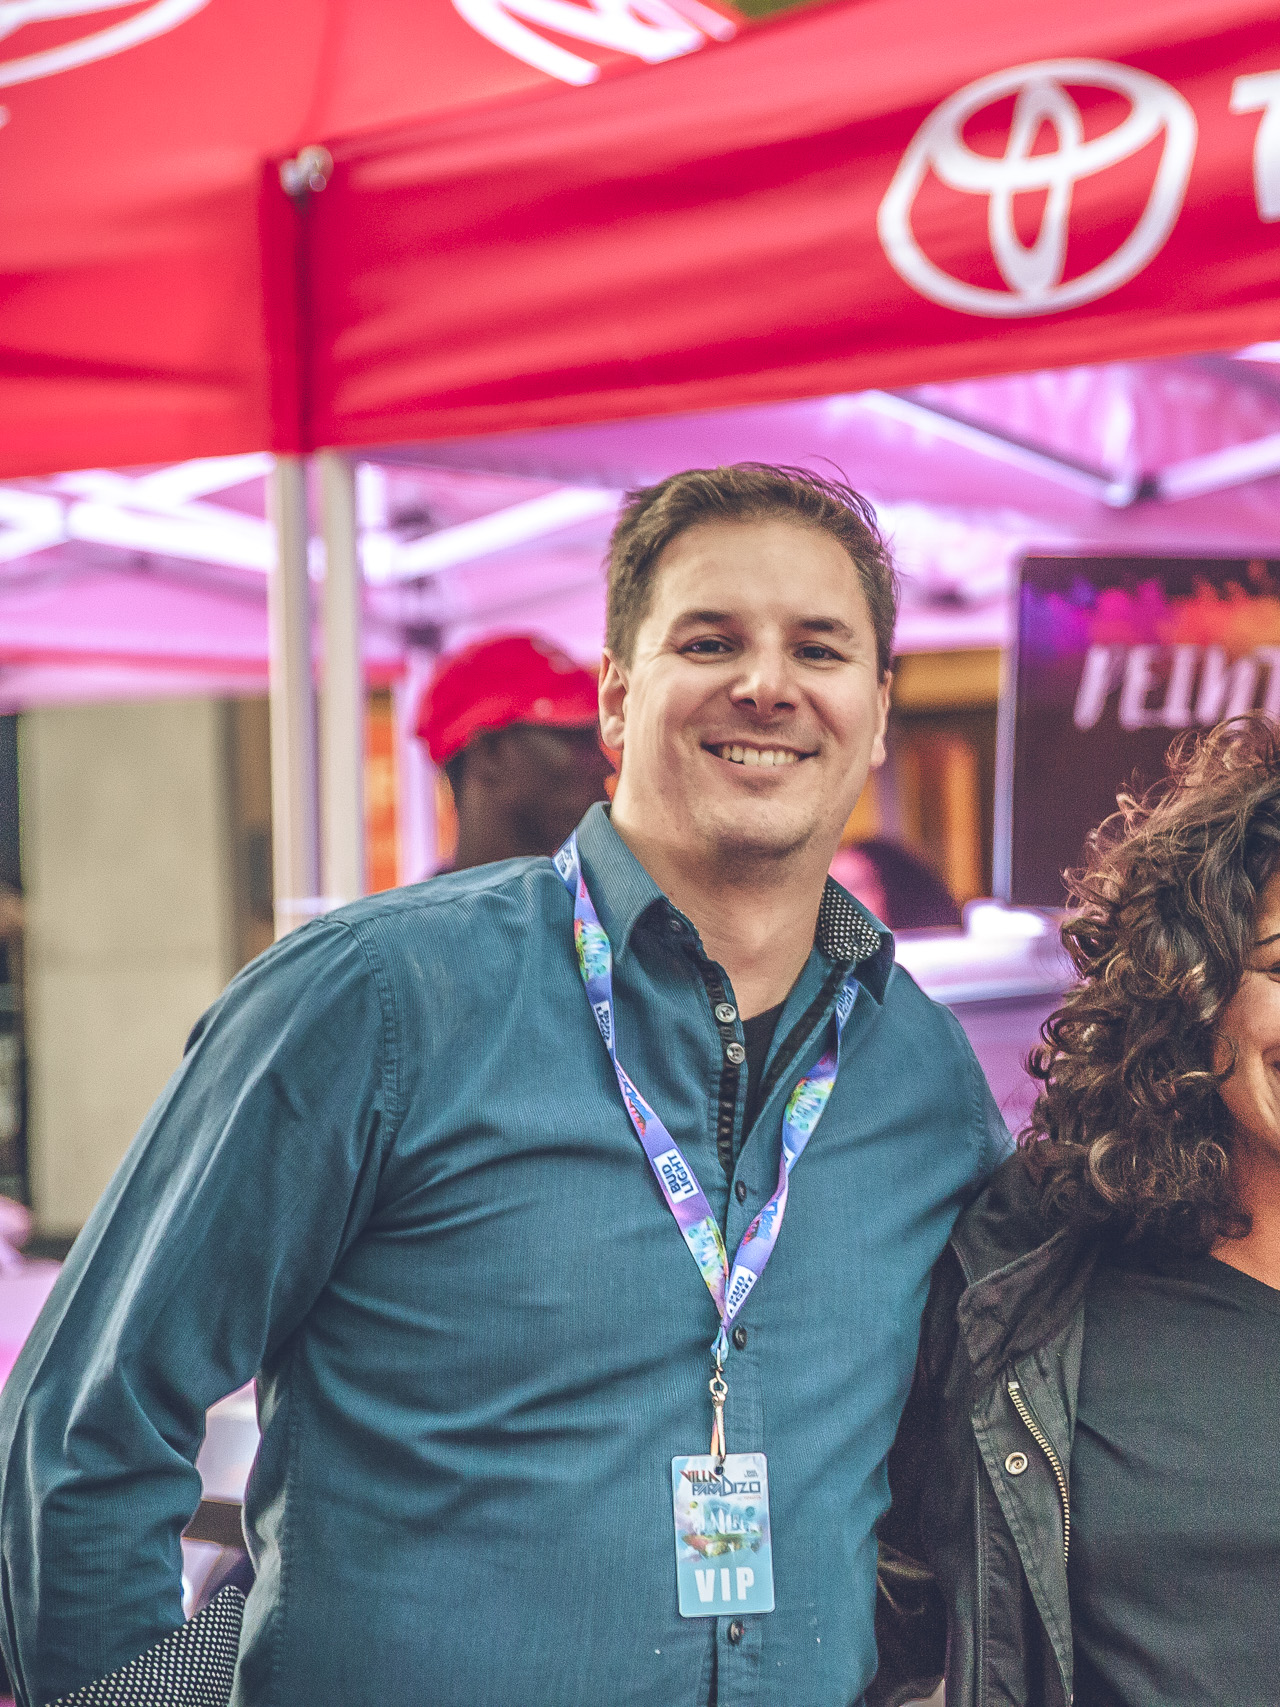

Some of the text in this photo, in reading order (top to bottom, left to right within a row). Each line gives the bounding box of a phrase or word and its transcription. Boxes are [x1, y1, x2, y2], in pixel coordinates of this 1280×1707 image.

[661, 1163, 681, 1195] BUD
[667, 1154, 694, 1195] LIGHT
[692, 1474, 761, 1497] PARADIZO
[694, 1567, 755, 1603] VIP
